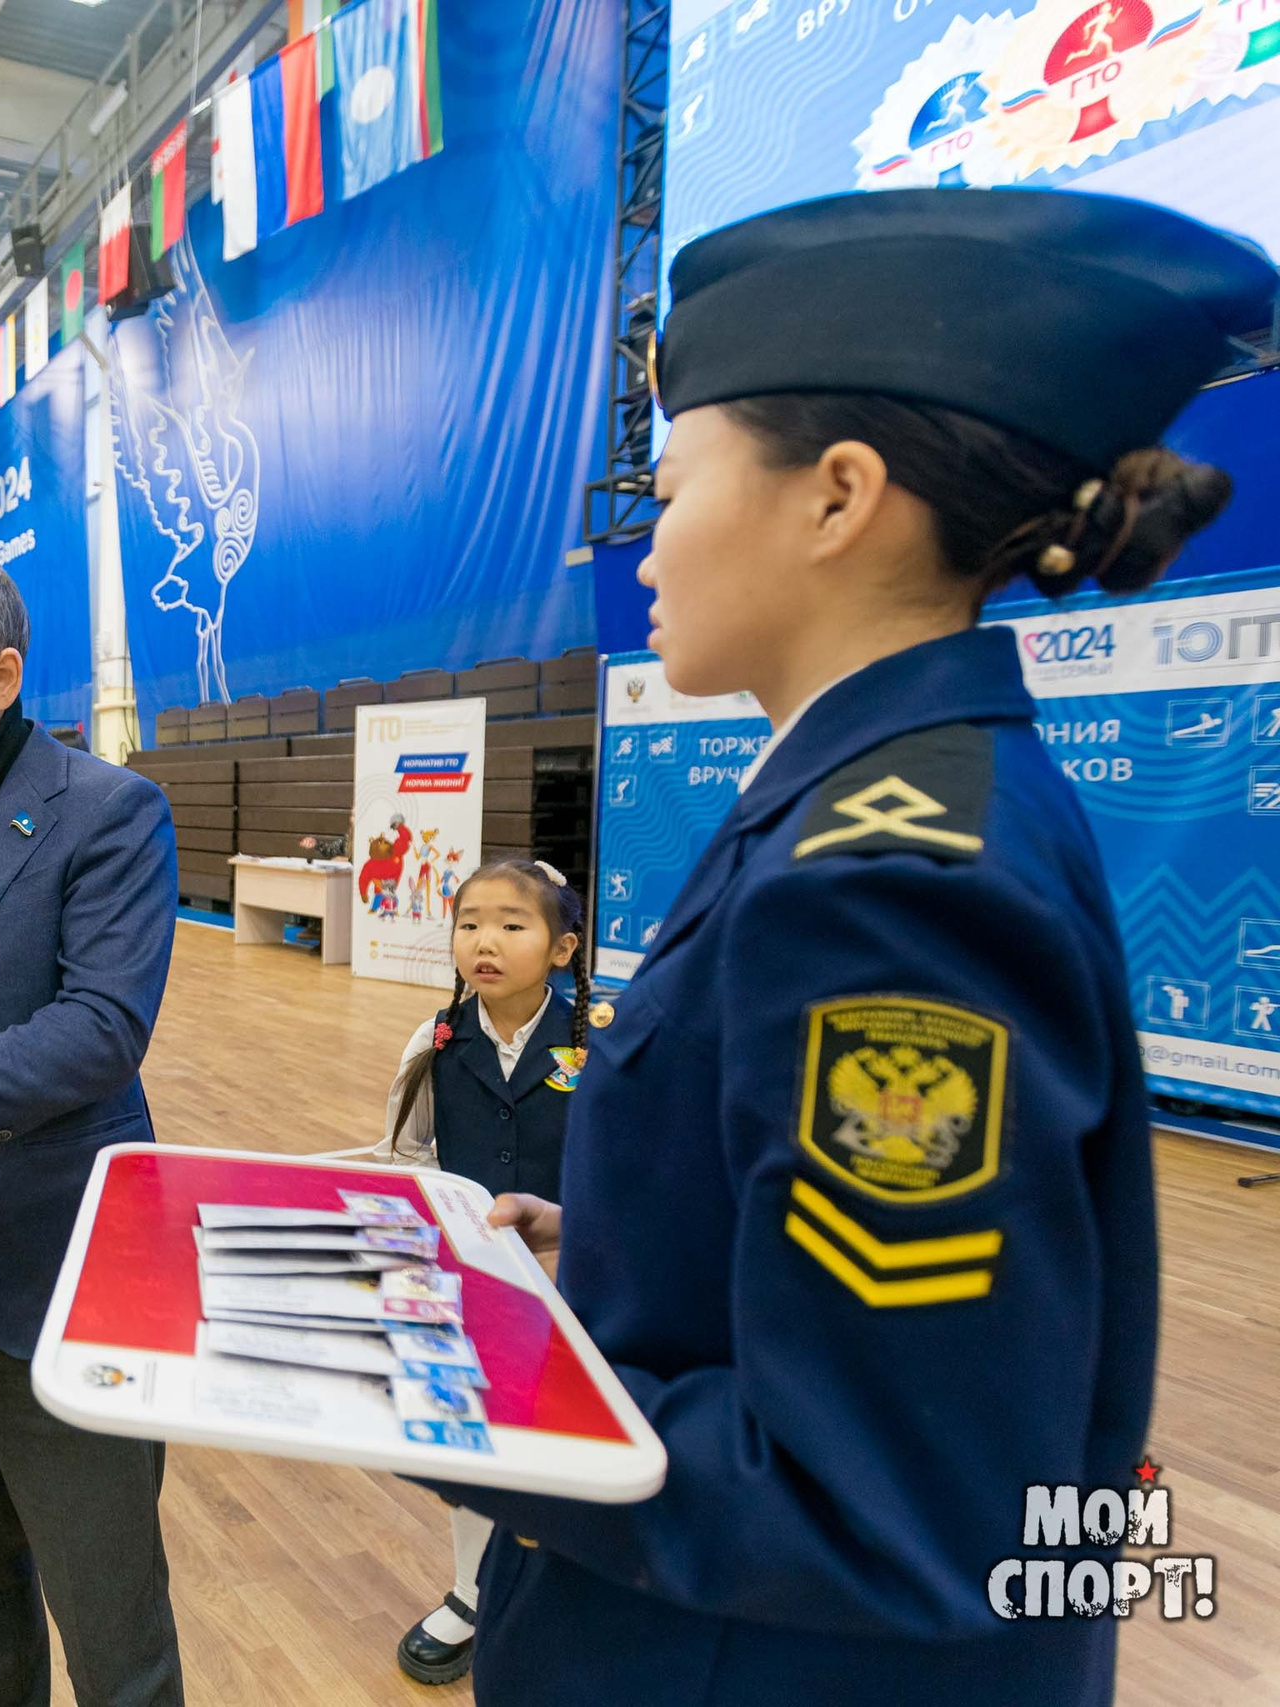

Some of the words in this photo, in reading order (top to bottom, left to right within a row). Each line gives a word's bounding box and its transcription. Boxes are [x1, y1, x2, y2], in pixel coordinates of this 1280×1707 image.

[1070, 61, 1122, 99] ГТО
[930, 131, 974, 165] ГТО
[1035, 623, 1116, 663] 2024
